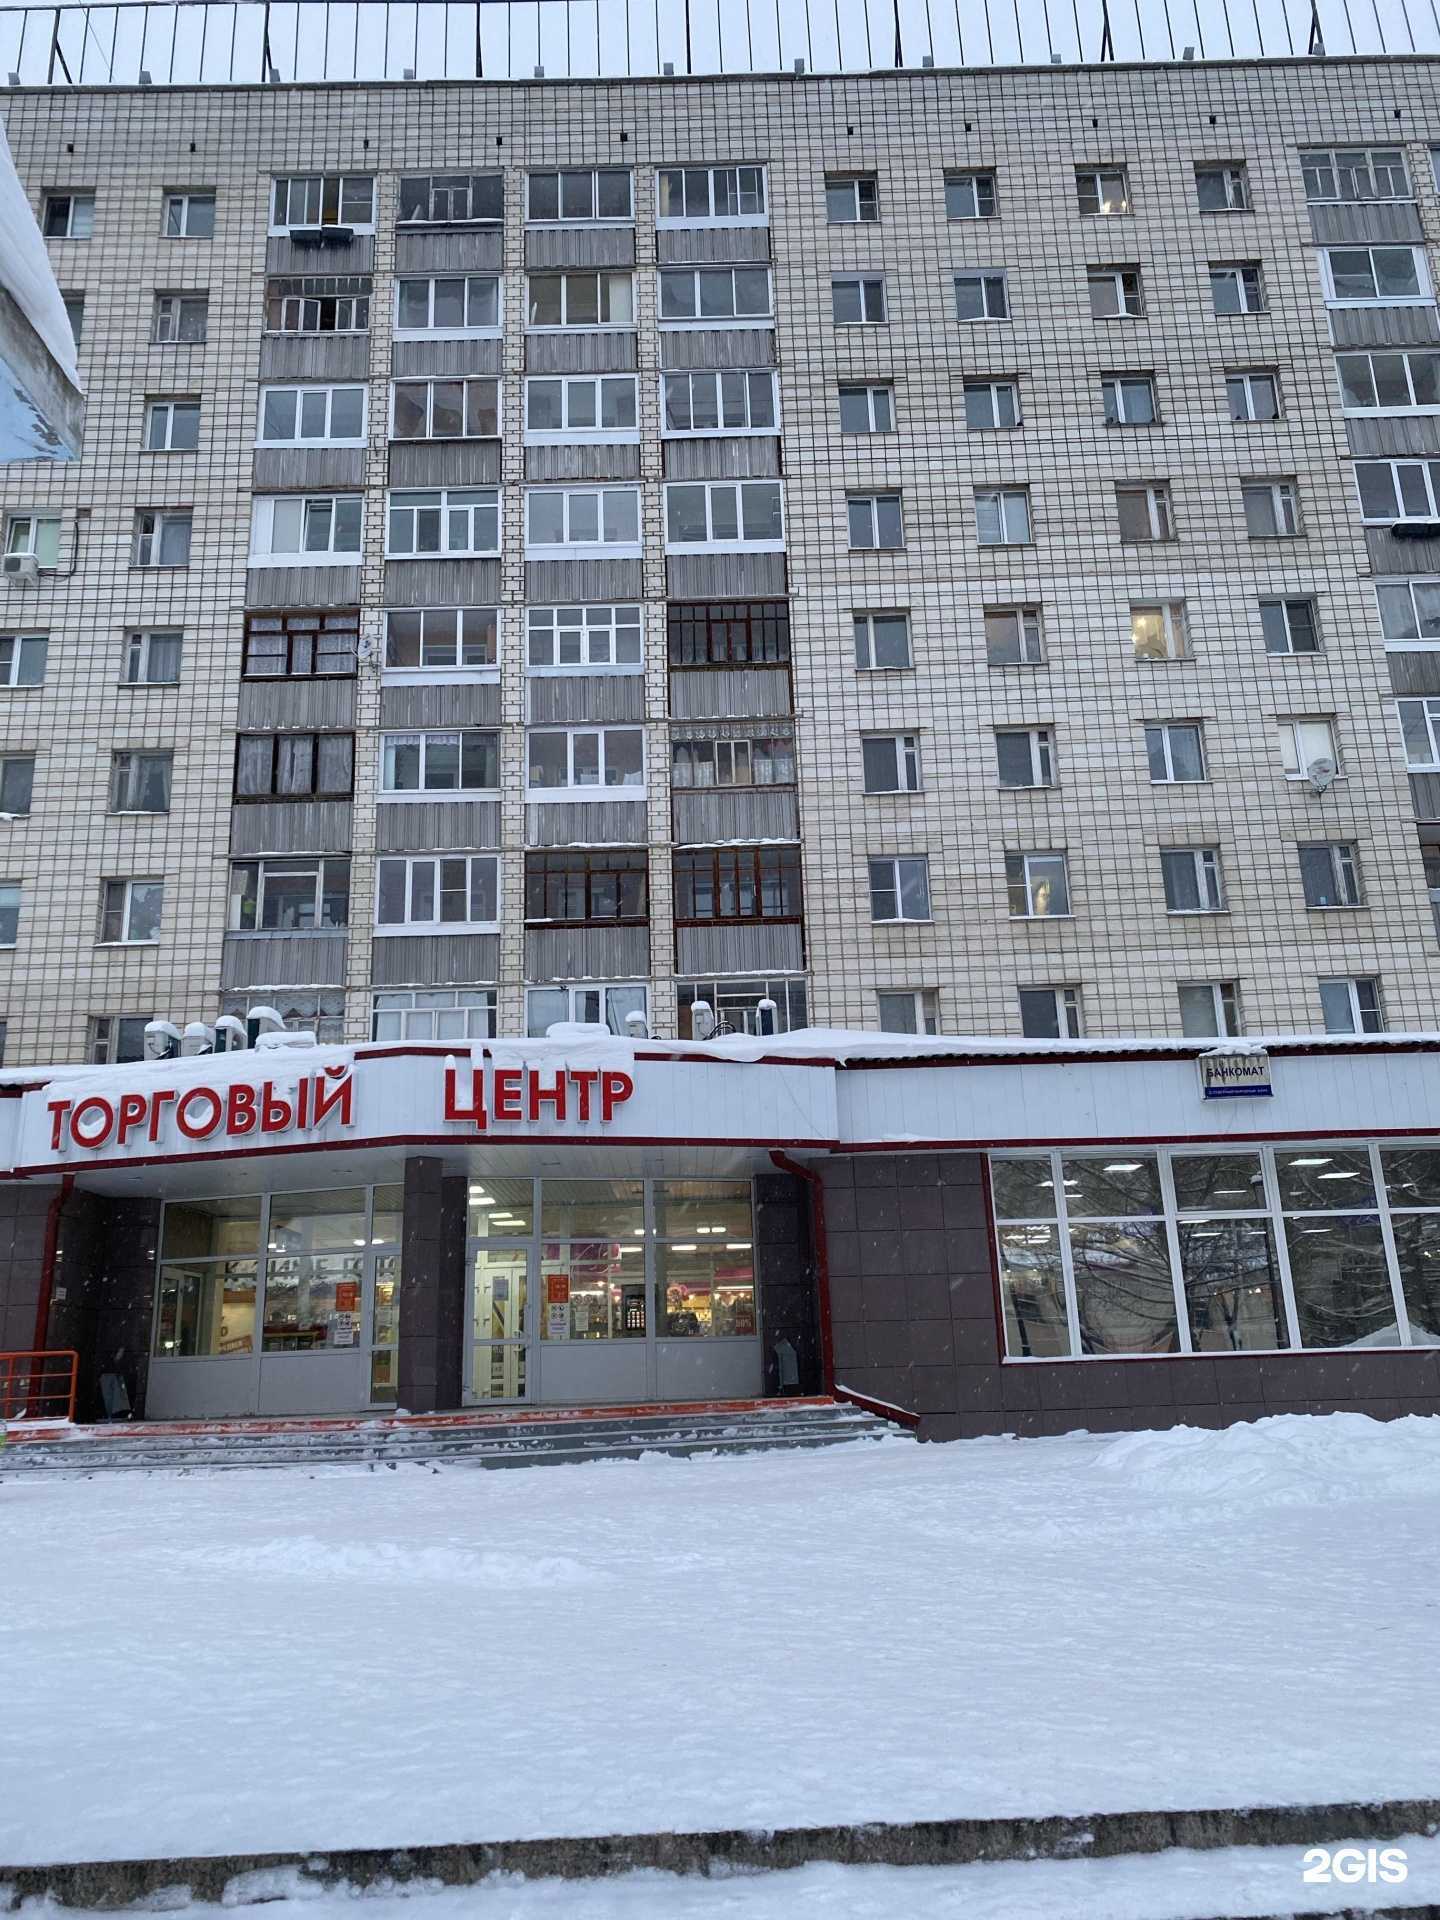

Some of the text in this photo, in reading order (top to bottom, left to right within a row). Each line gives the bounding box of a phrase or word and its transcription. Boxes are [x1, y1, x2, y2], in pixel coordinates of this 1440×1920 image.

[1206, 1066, 1264, 1077] БАНКОМАТ
[47, 1065, 635, 1151] ТОРГОВЫЙ ЦЕНТР
